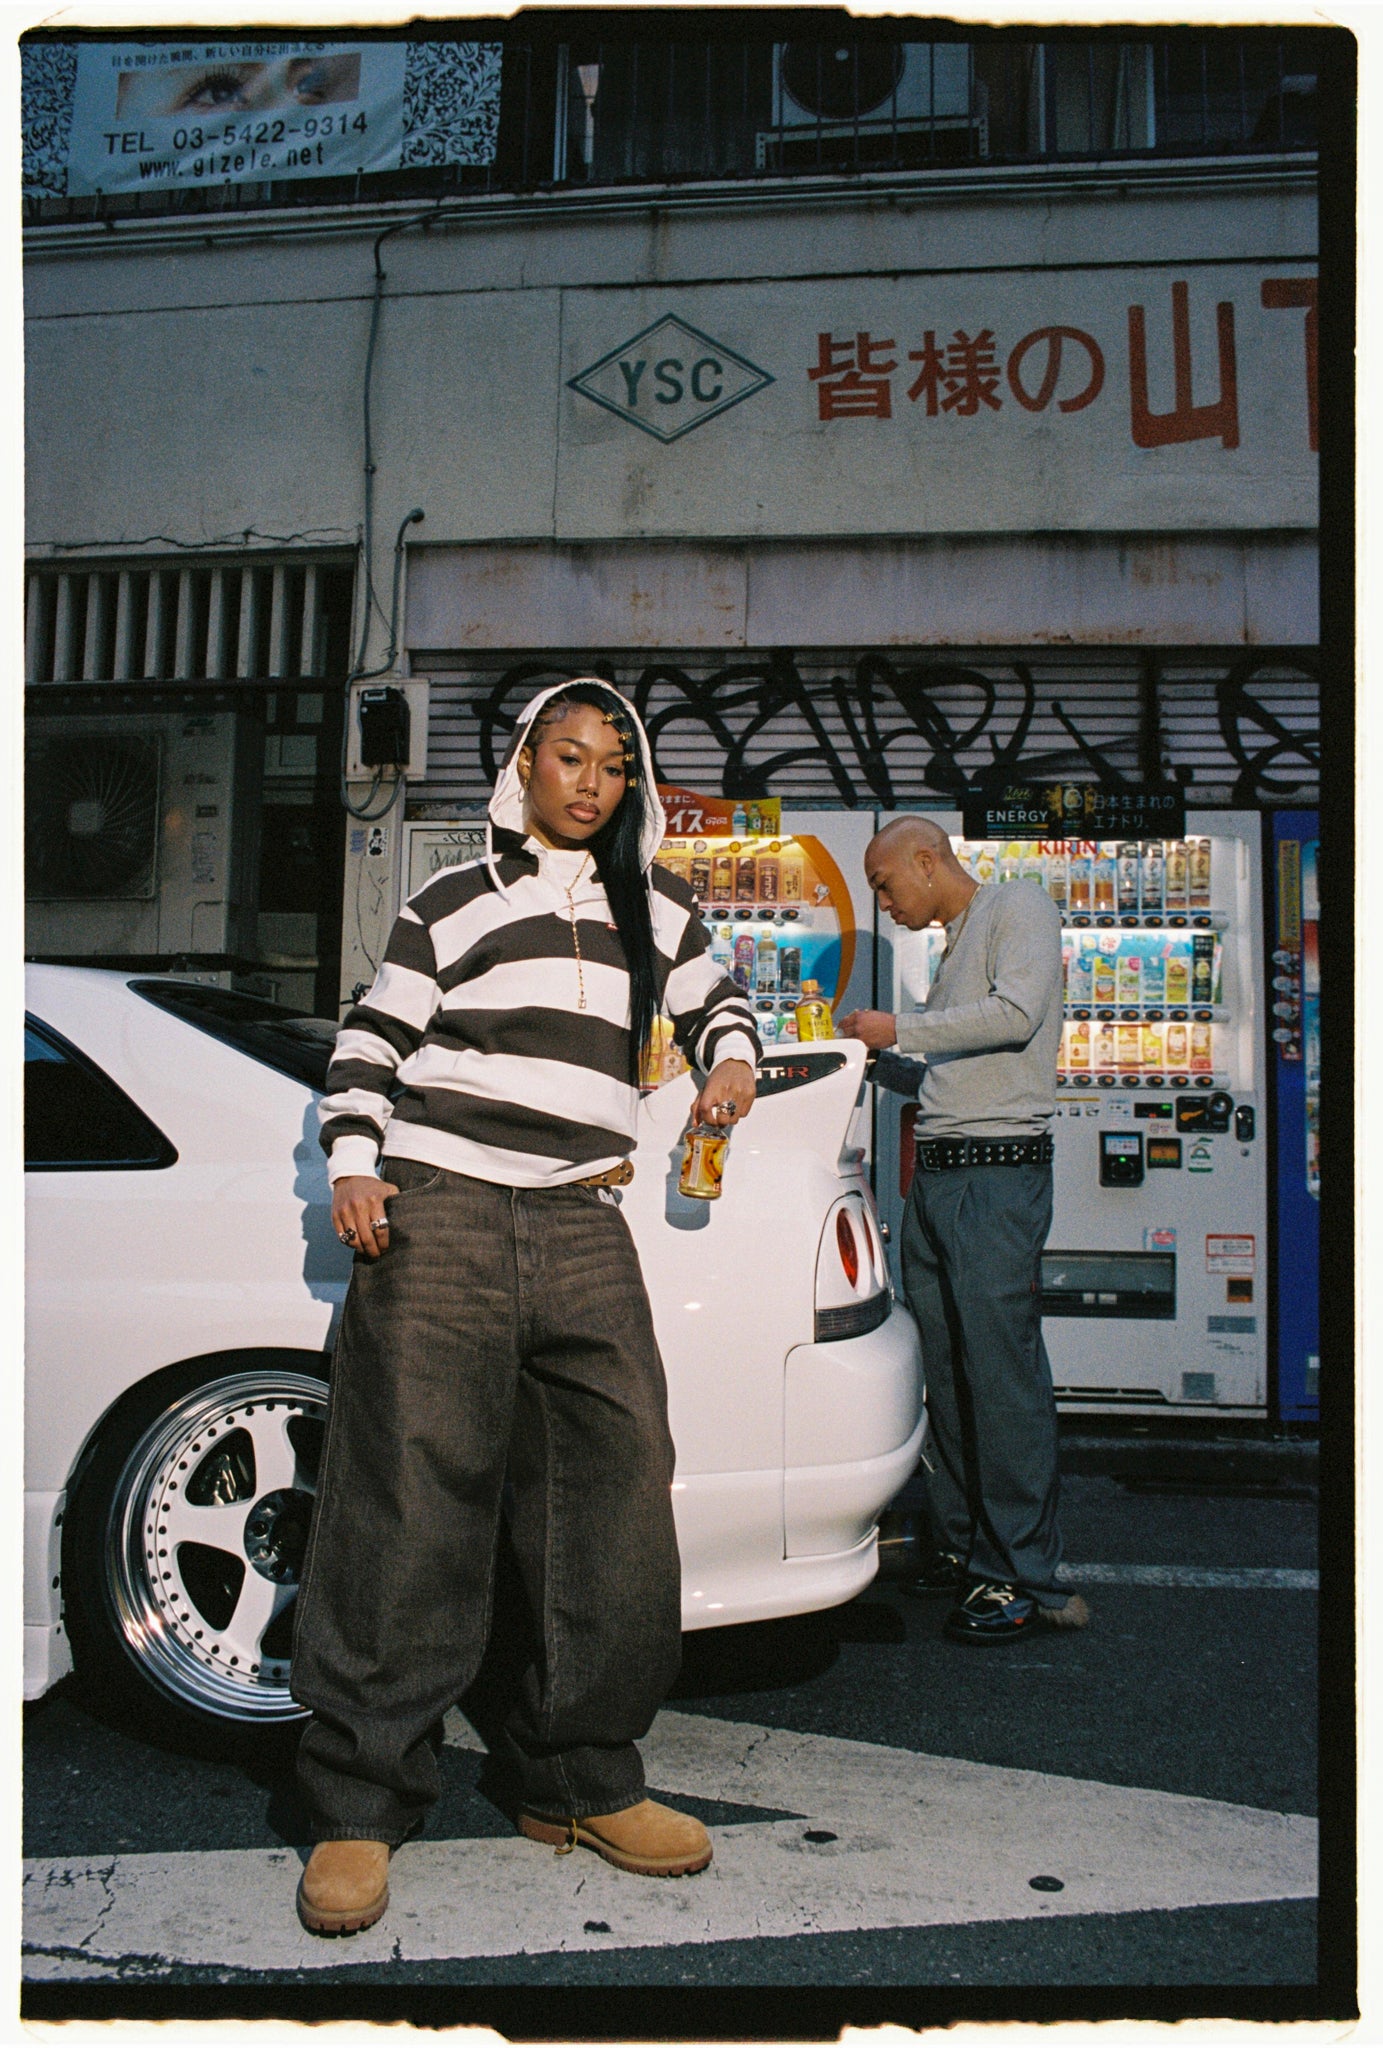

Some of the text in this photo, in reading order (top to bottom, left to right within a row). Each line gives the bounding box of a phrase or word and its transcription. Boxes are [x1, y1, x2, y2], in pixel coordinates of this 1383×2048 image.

[103, 112, 368, 154] TEL 03-5422-9314
[618, 357, 723, 407] YSC
[1093, 794, 1176, 810] 日本生まれの
[986, 810, 1049, 823] ENERGY
[1037, 840, 1098, 855] KIRIN
